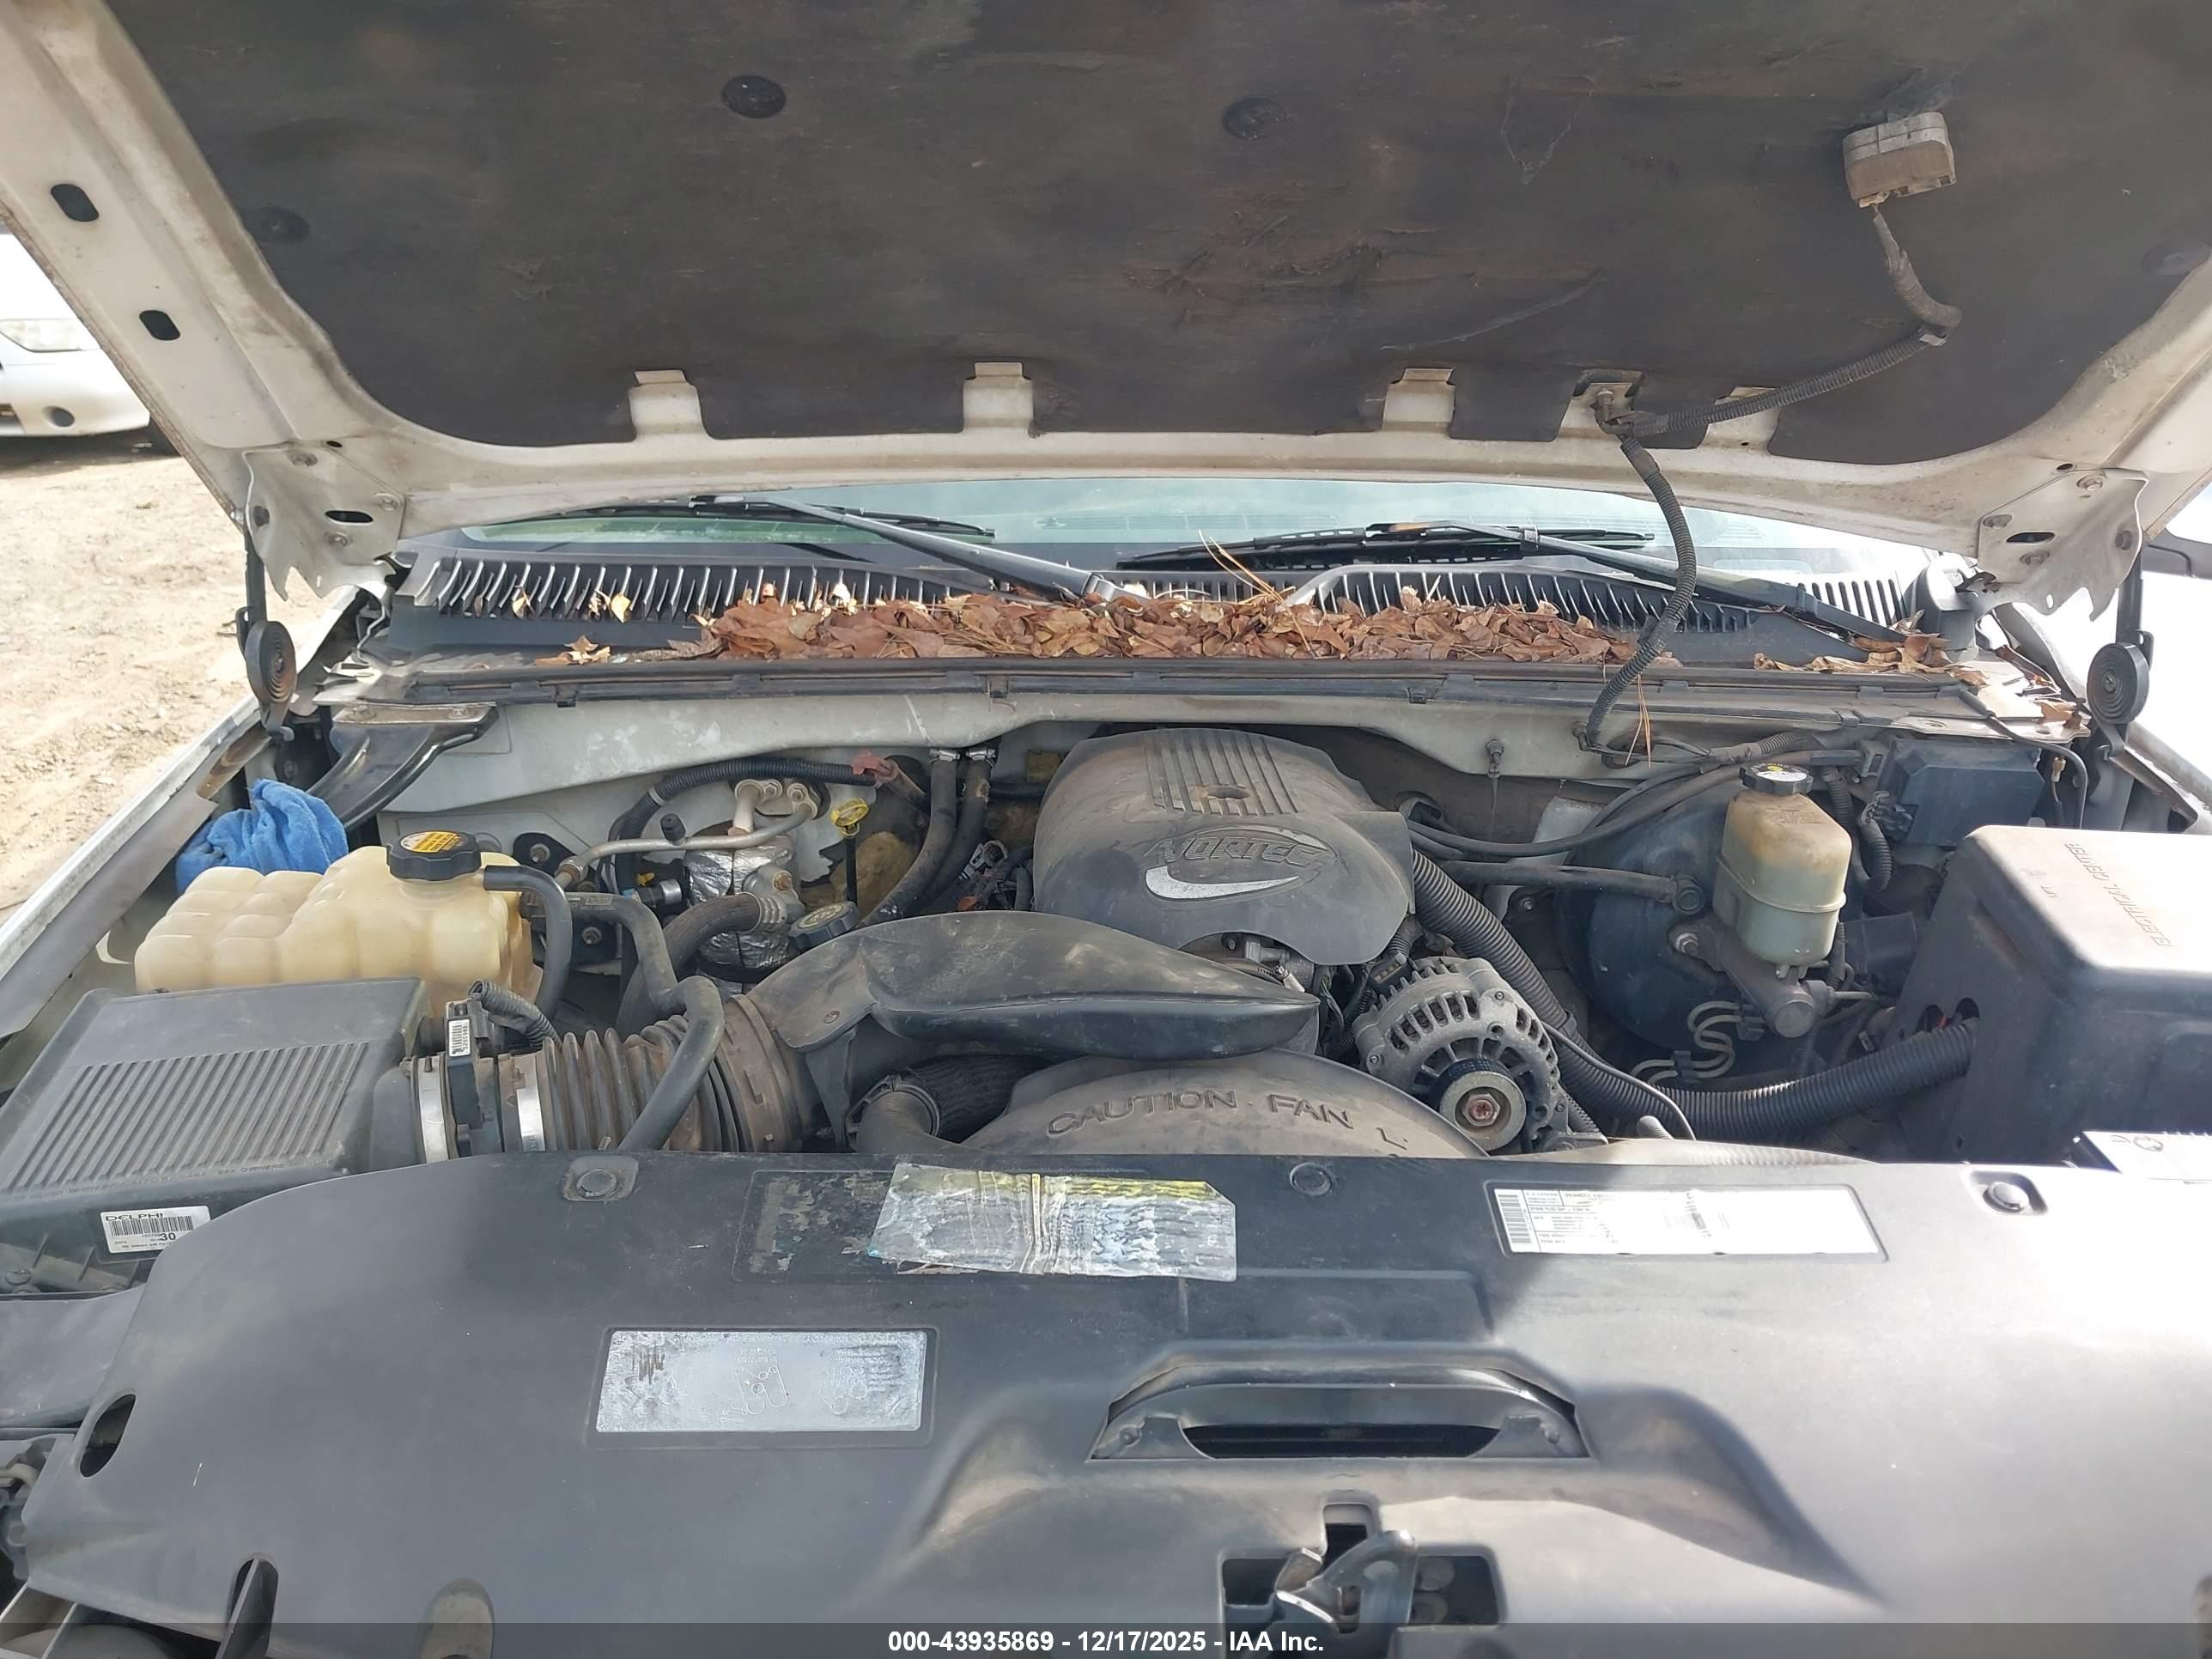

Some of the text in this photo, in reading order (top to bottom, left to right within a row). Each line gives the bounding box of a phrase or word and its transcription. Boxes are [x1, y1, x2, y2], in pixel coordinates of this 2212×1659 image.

[1147, 836, 1325, 868] VORTEC
[2063, 841, 2176, 948] ELECTRICAL CENTER
[1047, 1088, 1237, 1138] CAUTION
[1267, 1092, 1355, 1131] FAN
[105, 1212, 164, 1221] DELPHI
[158, 1232, 177, 1241] 30
